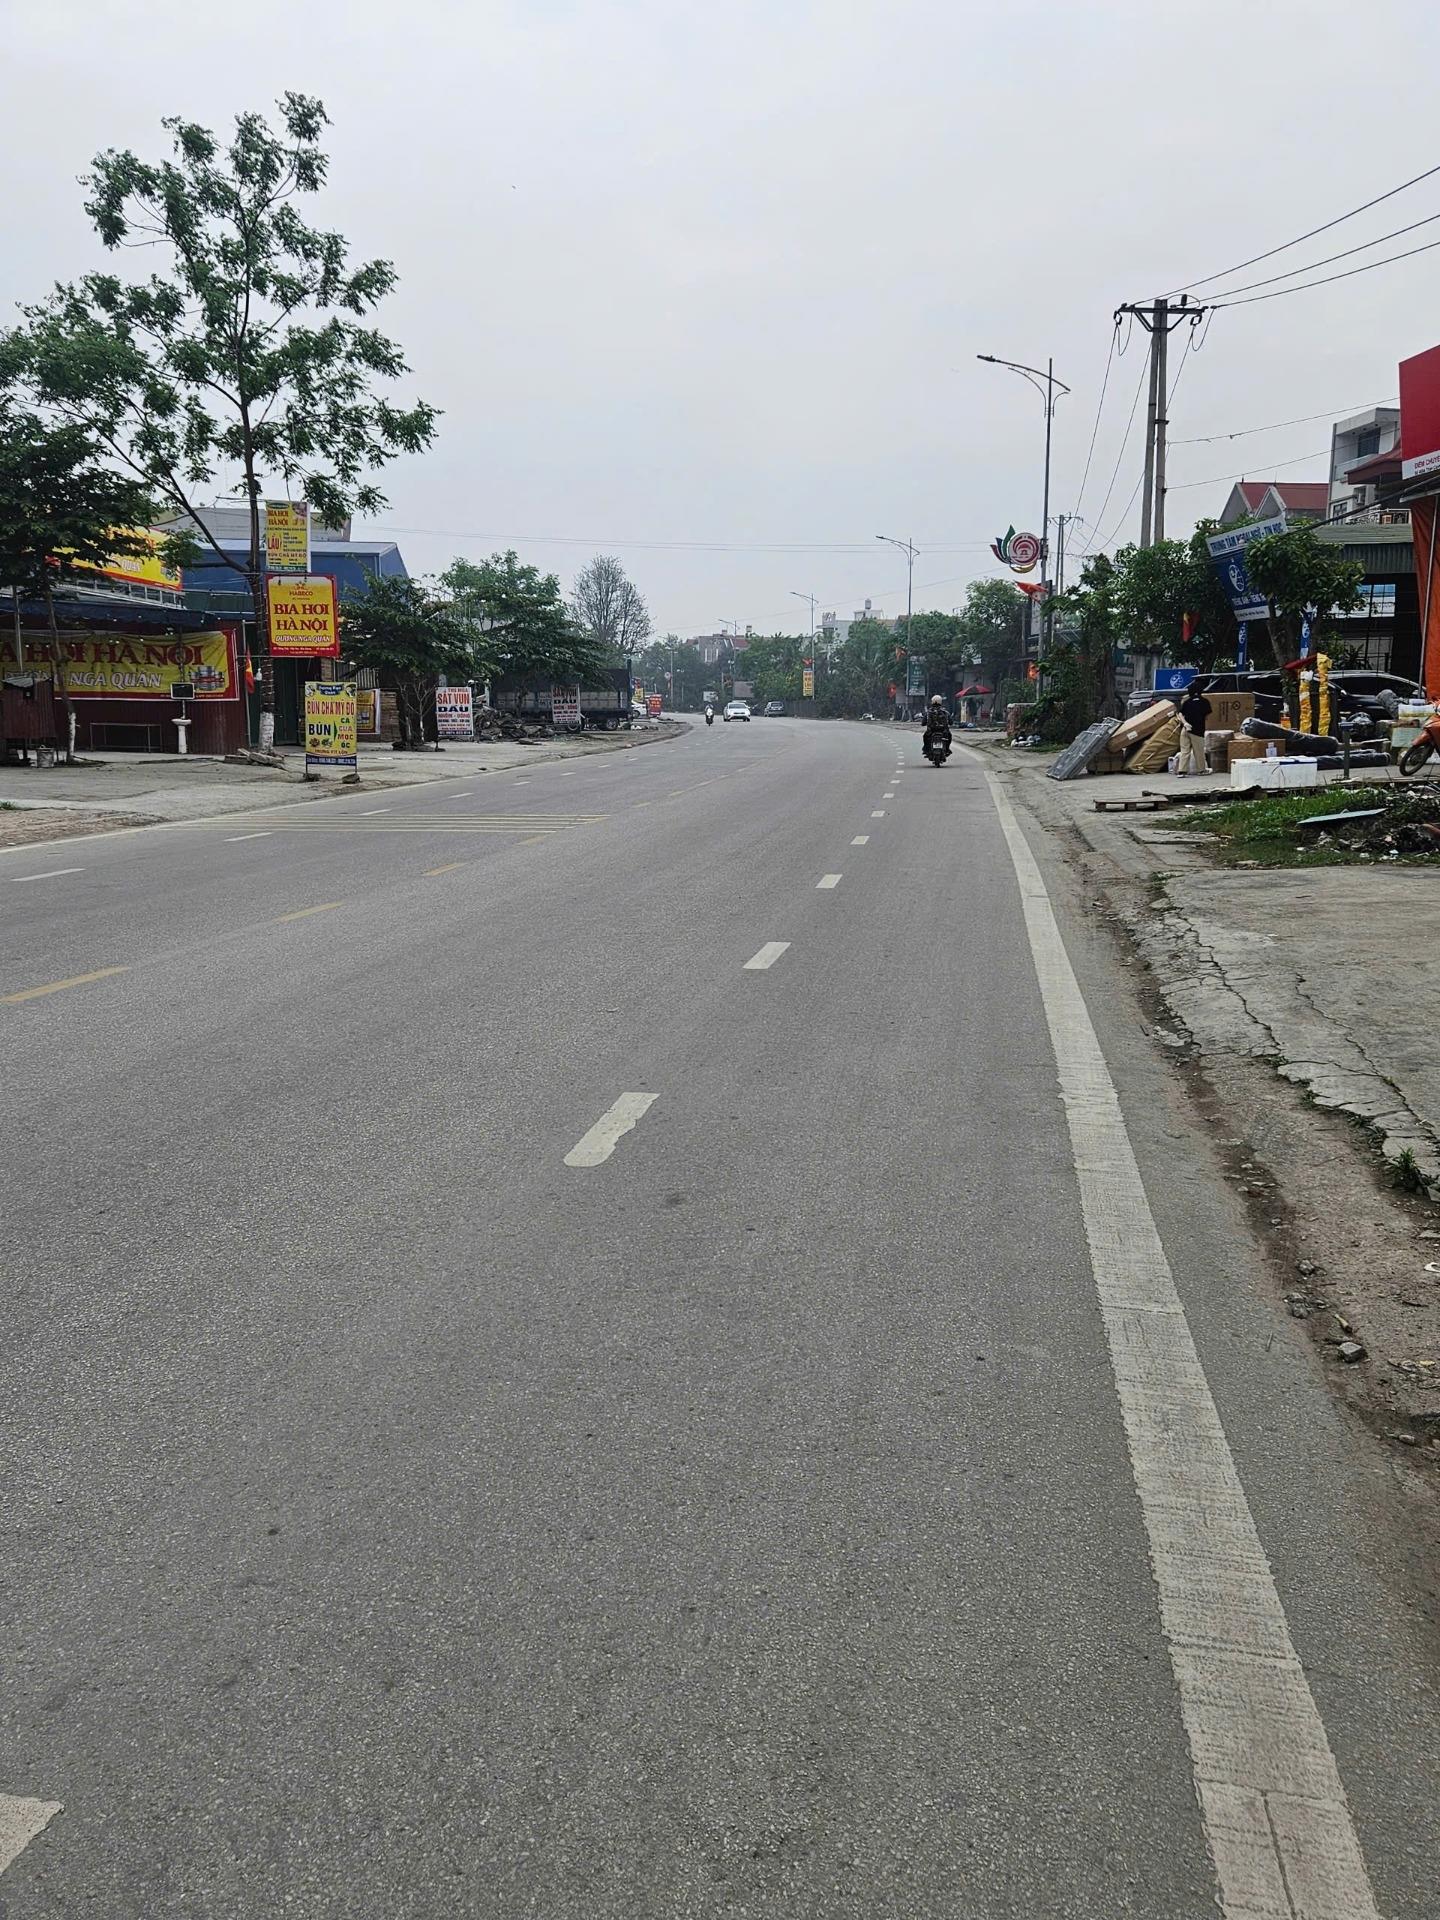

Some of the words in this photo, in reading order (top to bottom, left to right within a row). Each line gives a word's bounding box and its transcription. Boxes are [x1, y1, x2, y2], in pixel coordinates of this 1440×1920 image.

[1210, 539, 1227, 553] TRUNG
[1225, 535, 1237, 547] TÂM
[273, 603, 299, 615] BIA
[301, 602, 329, 615] HƠI
[276, 616, 298, 631] HÀ
[299, 617, 328, 633] NỘI
[69, 671, 107, 687] NGA
[111, 668, 162, 690] QUÁN
[306, 698, 320, 715] BÚN
[321, 698, 334, 715] CHẢ
[308, 721, 331, 736] BÚN
